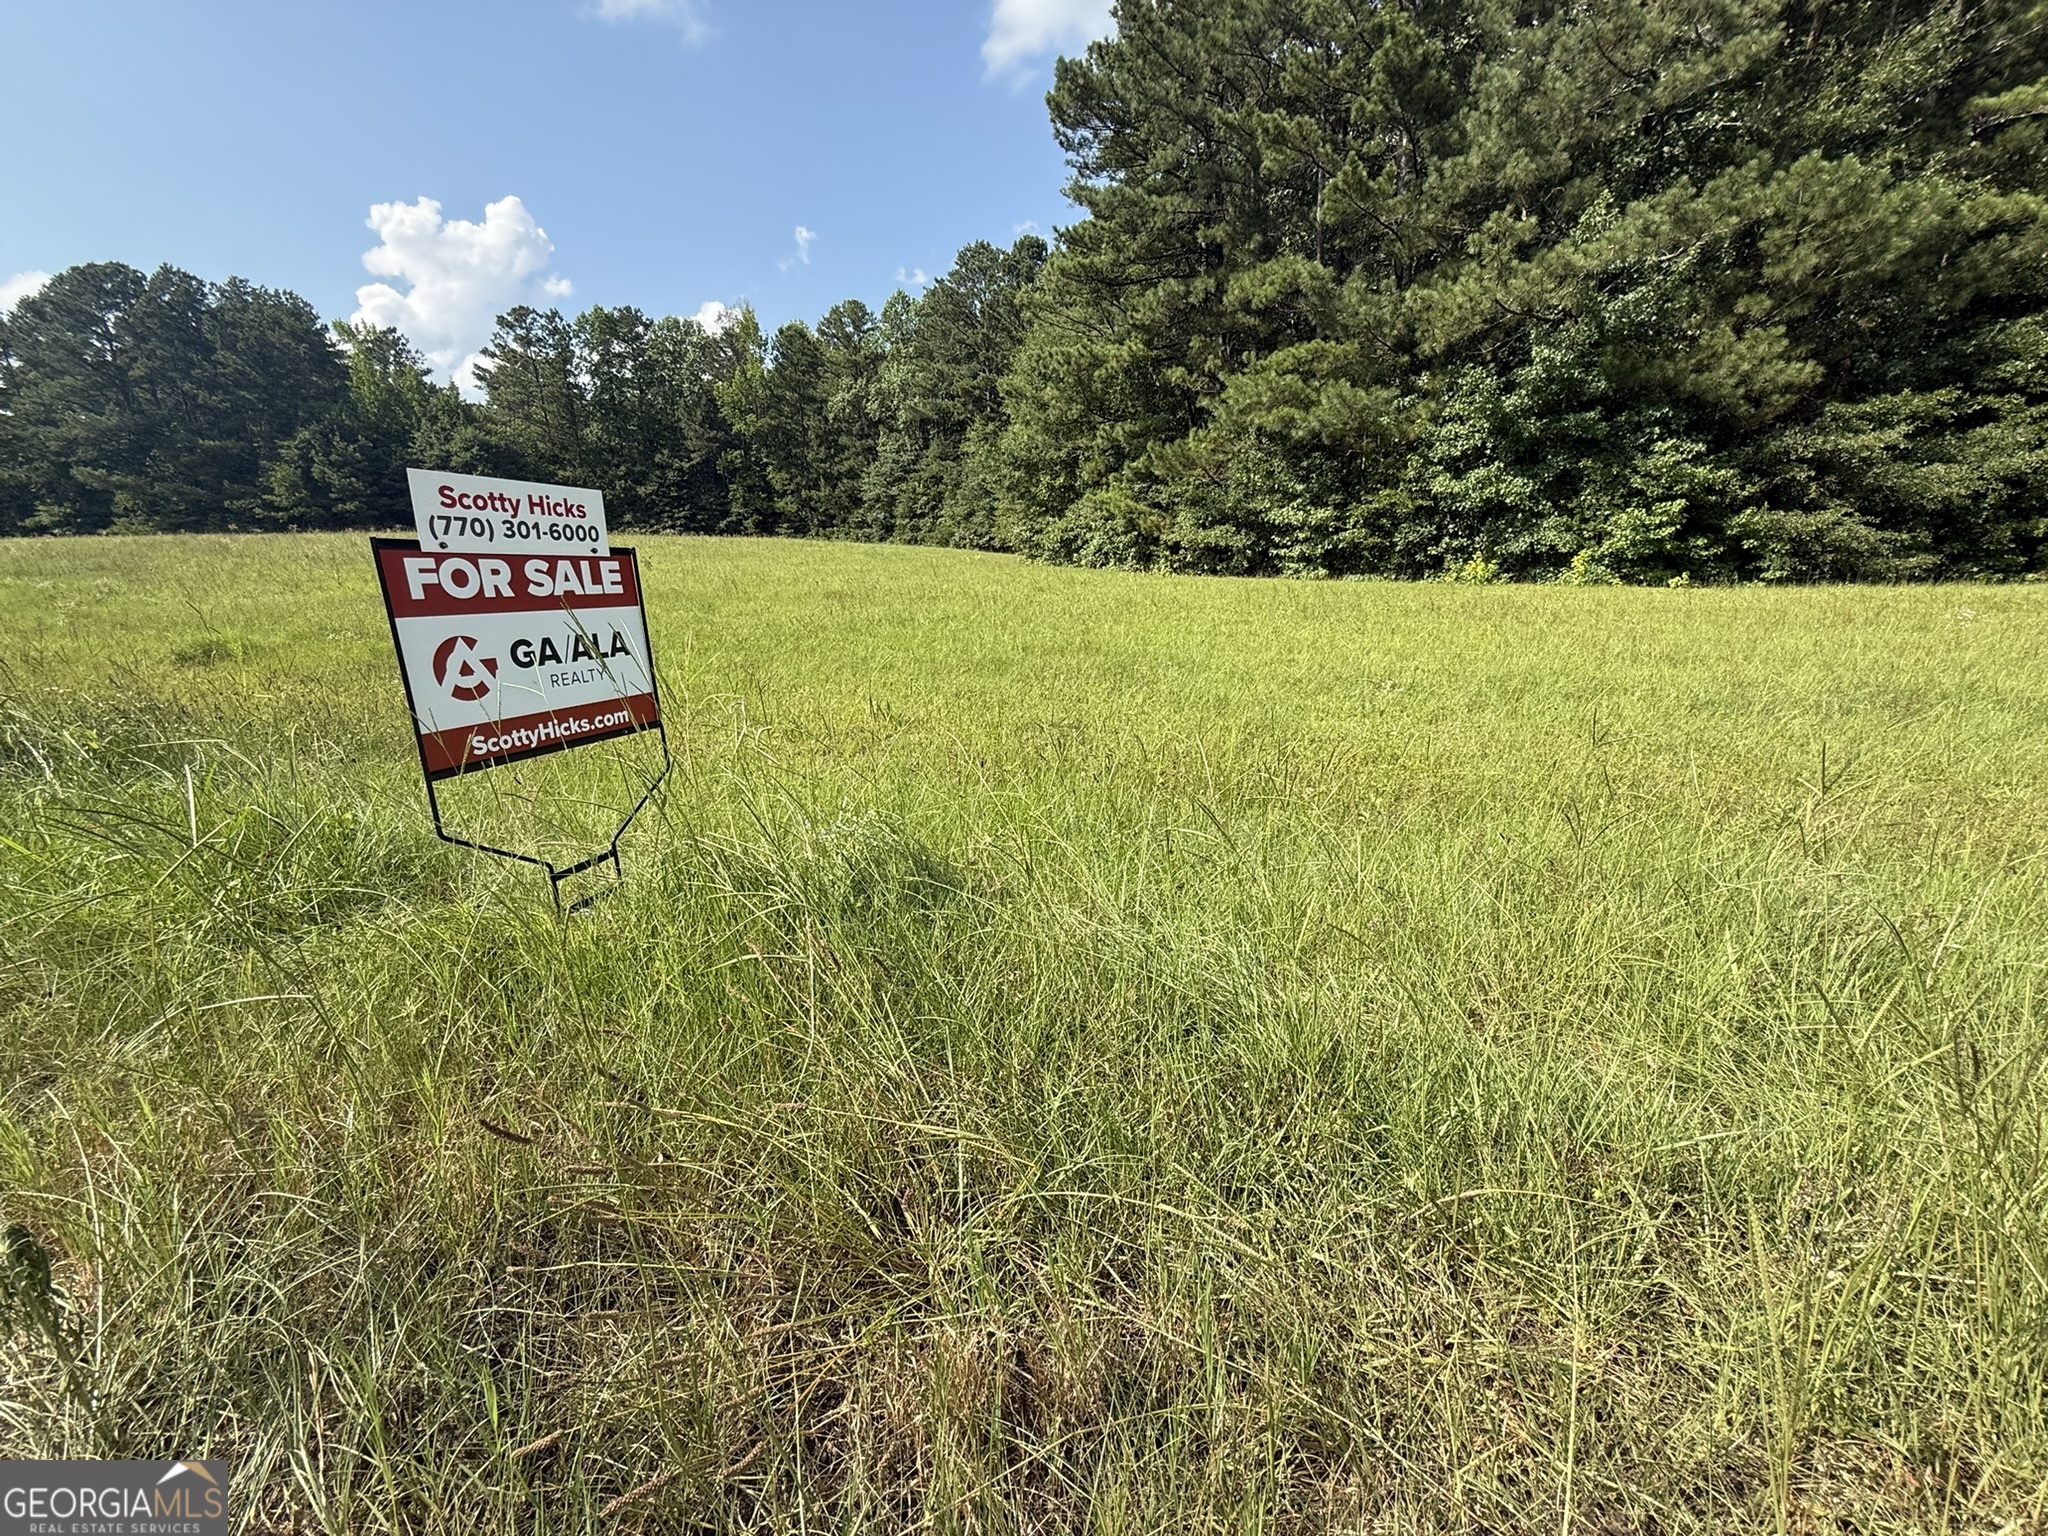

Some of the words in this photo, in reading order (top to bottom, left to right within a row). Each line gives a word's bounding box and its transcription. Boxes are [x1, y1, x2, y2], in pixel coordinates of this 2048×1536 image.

[438, 484, 521, 519] Scotty
[527, 494, 587, 519] Hicks
[428, 514, 495, 543] (770)
[502, 519, 600, 543] 301-6000
[403, 557, 516, 600] FOR
[524, 558, 624, 597] SALE
[550, 667, 608, 689] REALTY
[471, 709, 630, 756] ScottyHicks.com
